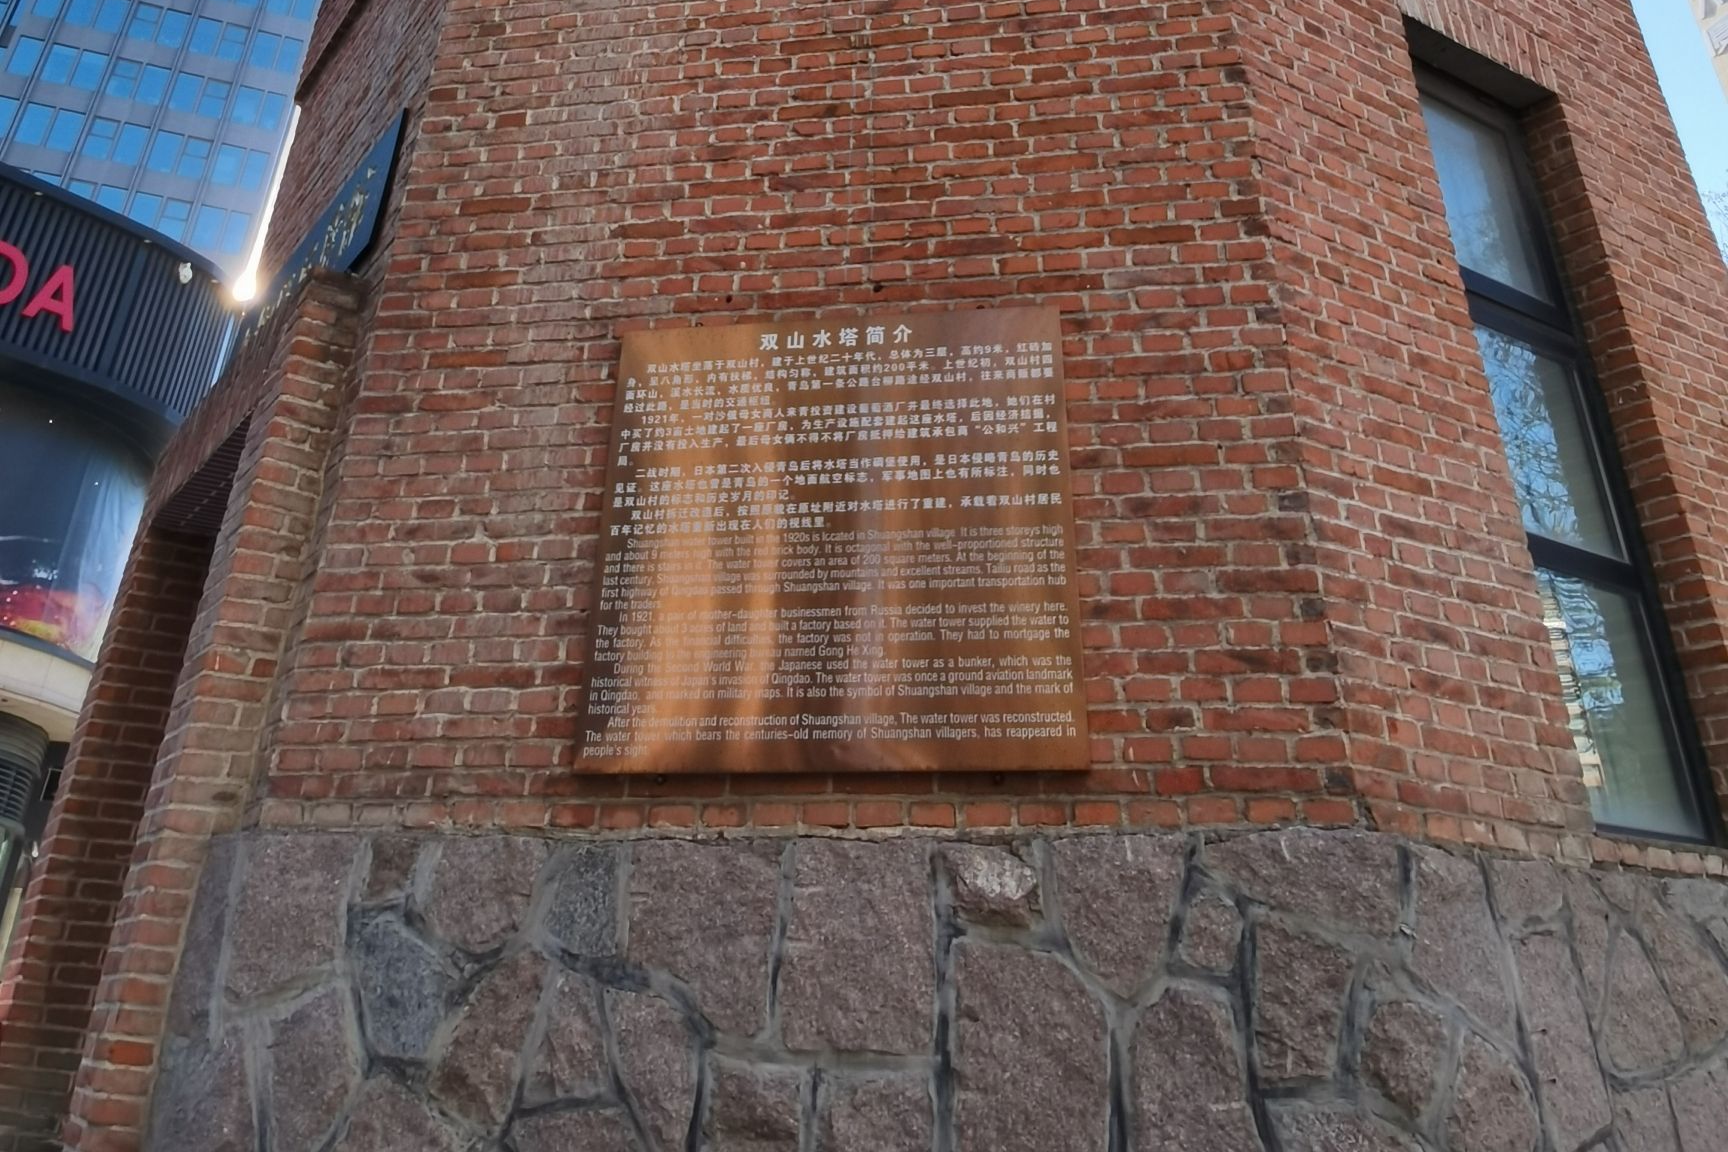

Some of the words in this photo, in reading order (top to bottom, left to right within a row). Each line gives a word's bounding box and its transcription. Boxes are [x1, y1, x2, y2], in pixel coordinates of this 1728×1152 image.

[759, 324, 912, 350] 双山水塔简介
[782, 532, 810, 543] 1920s
[811, 532, 820, 542] is
[821, 531, 854, 541] located
[960, 527, 967, 537] It
[969, 527, 977, 536] is
[1041, 524, 1063, 536] high
[605, 551, 621, 561] and
[624, 550, 648, 560] about
[651, 550, 657, 559] 9
[824, 544, 831, 554] It
[834, 544, 842, 553] is
[915, 541, 930, 550] the
[933, 538, 1017, 552] well-proportioned
[1020, 536, 1063, 547] structure
[604, 563, 620, 573] and
[622, 562, 645, 572] there
[647, 562, 655, 572] is
[781, 559, 811, 567] covers
[828, 558, 847, 566] area
[850, 556, 859, 565] of
[862, 555, 880, 565] 200
[955, 552, 966, 562] At
[969, 552, 983, 562] the
[986, 550, 1034, 563] beginning
[1036, 550, 1046, 560] of
[1049, 549, 1064, 559] the
[602, 575, 618, 585] last
[816, 569, 828, 581] by
[899, 565, 940, 576] excellent
[1013, 562, 1035, 573] road
[1037, 564, 1048, 572] as
[1050, 562, 1065, 572] the
[601, 588, 618, 597] first
[782, 581, 839, 594] Shuangshan
[908, 581, 926, 589] one
[929, 577, 975, 590] important
[977, 575, 1044, 589] transportation
[1047, 575, 1066, 585] hub
[600, 600, 612, 610] for
[613, 600, 628, 609] the
[618, 612, 628, 622] In
[779, 606, 841, 618] businessmen
[844, 606, 866, 616] from
[905, 604, 942, 615] decided
[945, 603, 954, 613] to
[958, 603, 986, 613] invest
[989, 602, 1005, 612] the
[1008, 603, 1040, 614] winery
[597, 625, 618, 638] They
[791, 623, 796, 631] a
[798, 620, 831, 633] factory
[833, 619, 861, 630] based
[889, 618, 907, 628] The
[910, 617, 936, 628] water
[938, 616, 965, 627] tower
[968, 615, 1009, 628] supplied
[1011, 615, 1026, 625] the
[1029, 614, 1056, 625] water
[1058, 614, 1068, 624] to
[778, 634, 792, 644] the
[796, 633, 828, 646] factory
[832, 634, 851, 643] was
[939, 630, 963, 642] They
[967, 629, 985, 640] had
[989, 629, 999, 639] to
[1003, 627, 1050, 641] mortgage
[1054, 627, 1069, 638] the
[594, 651, 625, 663] factory
[783, 646, 815, 657] named
[817, 646, 844, 658] Gong
[613, 663, 644, 676] During
[777, 659, 822, 673] Japanese
[826, 659, 848, 669] used
[902, 657, 928, 668] tower
[932, 659, 944, 667] as
[948, 659, 954, 667] a
[998, 655, 1028, 666] which
[1031, 657, 1051, 665] was
[1055, 654, 1071, 665] the
[591, 676, 632, 687] historical
[815, 673, 833, 683] The
[835, 672, 861, 683] water
[892, 673, 912, 682] was
[914, 673, 937, 681] once
[939, 673, 945, 681] a
[947, 670, 983, 683] ground
[985, 669, 1024, 680] aviation
[1026, 668, 1072, 679] landmark
[589, 690, 598, 701] in
[786, 687, 793, 697] It
[795, 687, 804, 697] is
[807, 687, 826, 697] also
[829, 686, 844, 697] the
[846, 686, 881, 699] symbol
[884, 685, 894, 696] of
[897, 684, 957, 698] Shuangshan
[960, 684, 992, 697] village
[994, 683, 1013, 694] and
[1016, 683, 1031, 694] the
[1034, 683, 1060, 693] mark
[1062, 682, 1073, 693] of
[588, 703, 629, 714] historical
[607, 716, 630, 727] After
[719, 714, 787, 726] reconstruction
[789, 714, 798, 725] of
[801, 713, 861, 727] Shuangshan
[900, 713, 918, 724] The
[920, 712, 947, 723] water
[949, 712, 977, 723] tower
[980, 714, 1000, 723] was
[584, 731, 602, 741] The
[605, 731, 630, 741] water
[695, 730, 721, 740] bears
[725, 729, 740, 740] the
[744, 728, 808, 740] centuries-old
[812, 730, 852, 741] memory
[856, 728, 866, 739] of
[870, 727, 931, 741] Shuangshan
[983, 726, 1001, 737] has
[1005, 725, 1062, 739] reappeared
[1066, 725, 1075, 736] in
[582, 745, 622, 758] people's
